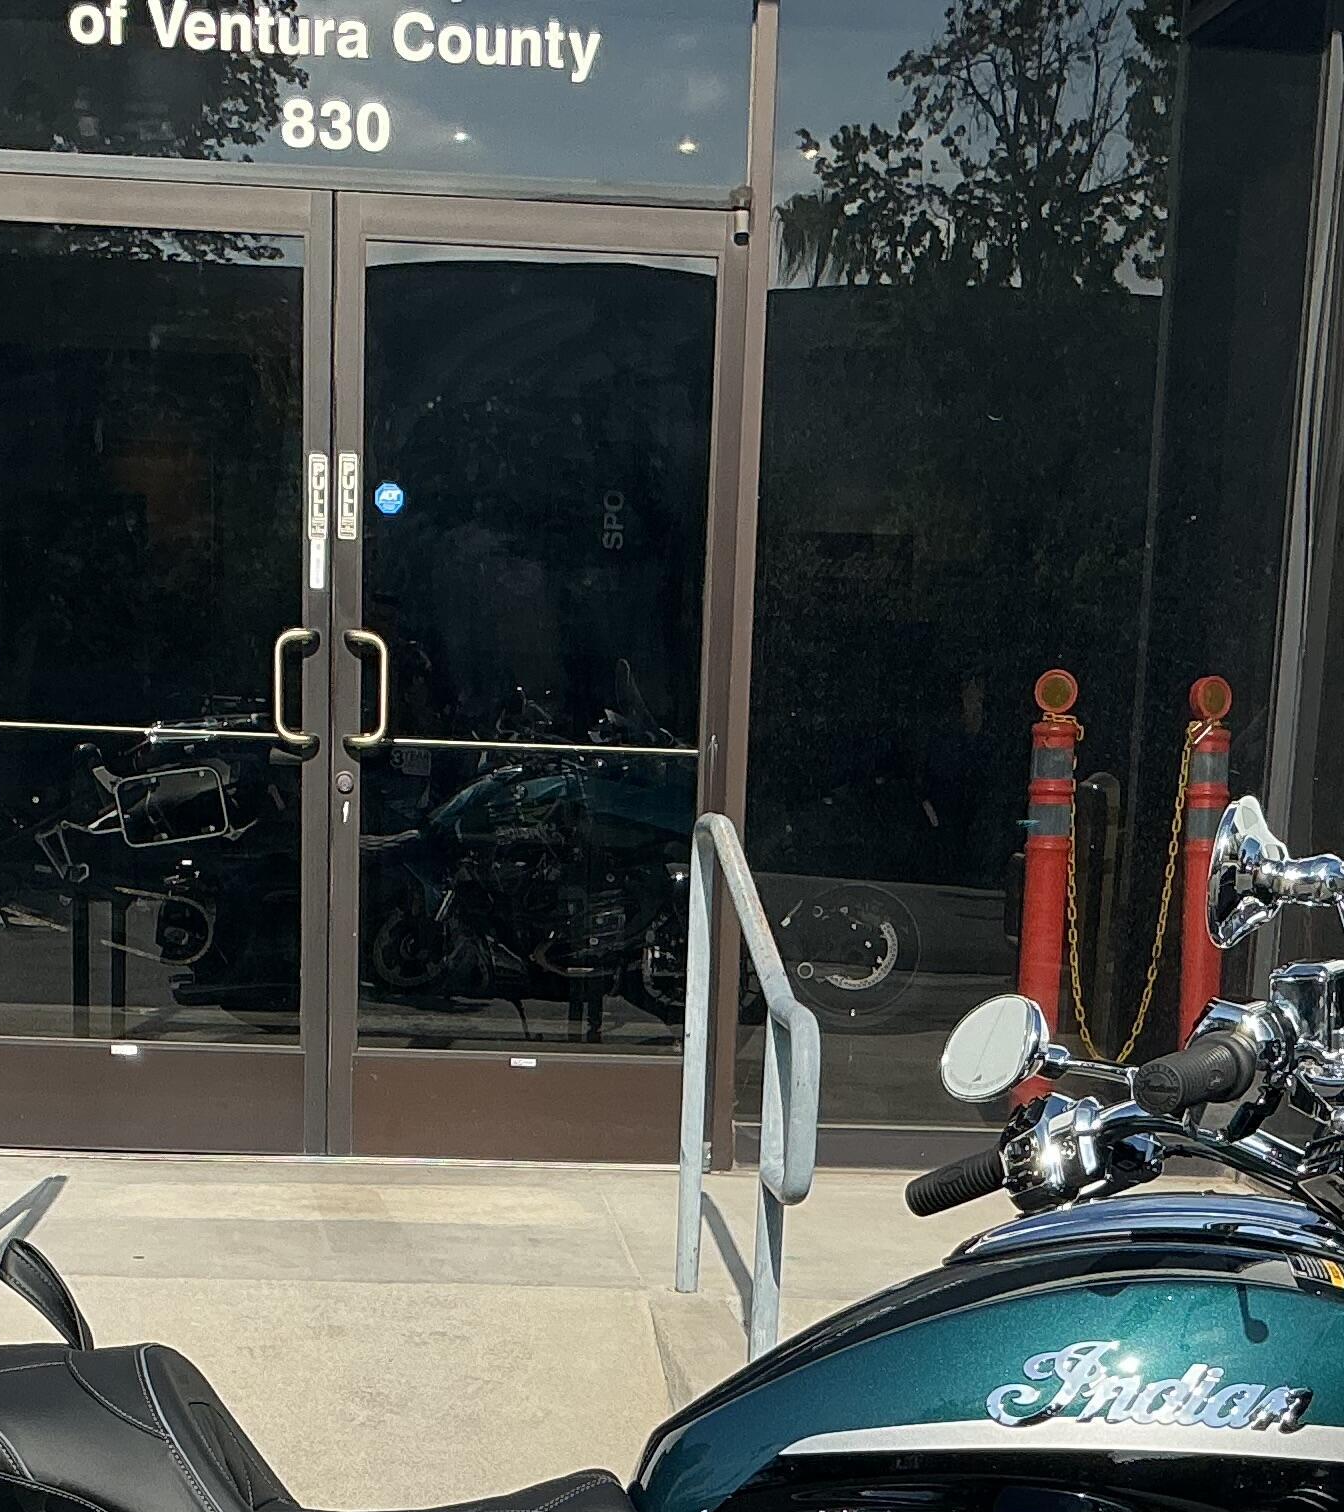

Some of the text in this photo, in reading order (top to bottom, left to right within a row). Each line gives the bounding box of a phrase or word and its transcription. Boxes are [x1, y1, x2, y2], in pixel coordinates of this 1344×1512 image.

[69, 0, 602, 83] of Ventura County
[281, 98, 391, 153] 830
[312, 462, 325, 517] PULL
[342, 461, 355, 517] PULL
[985, 1340, 1314, 1435] Indian
